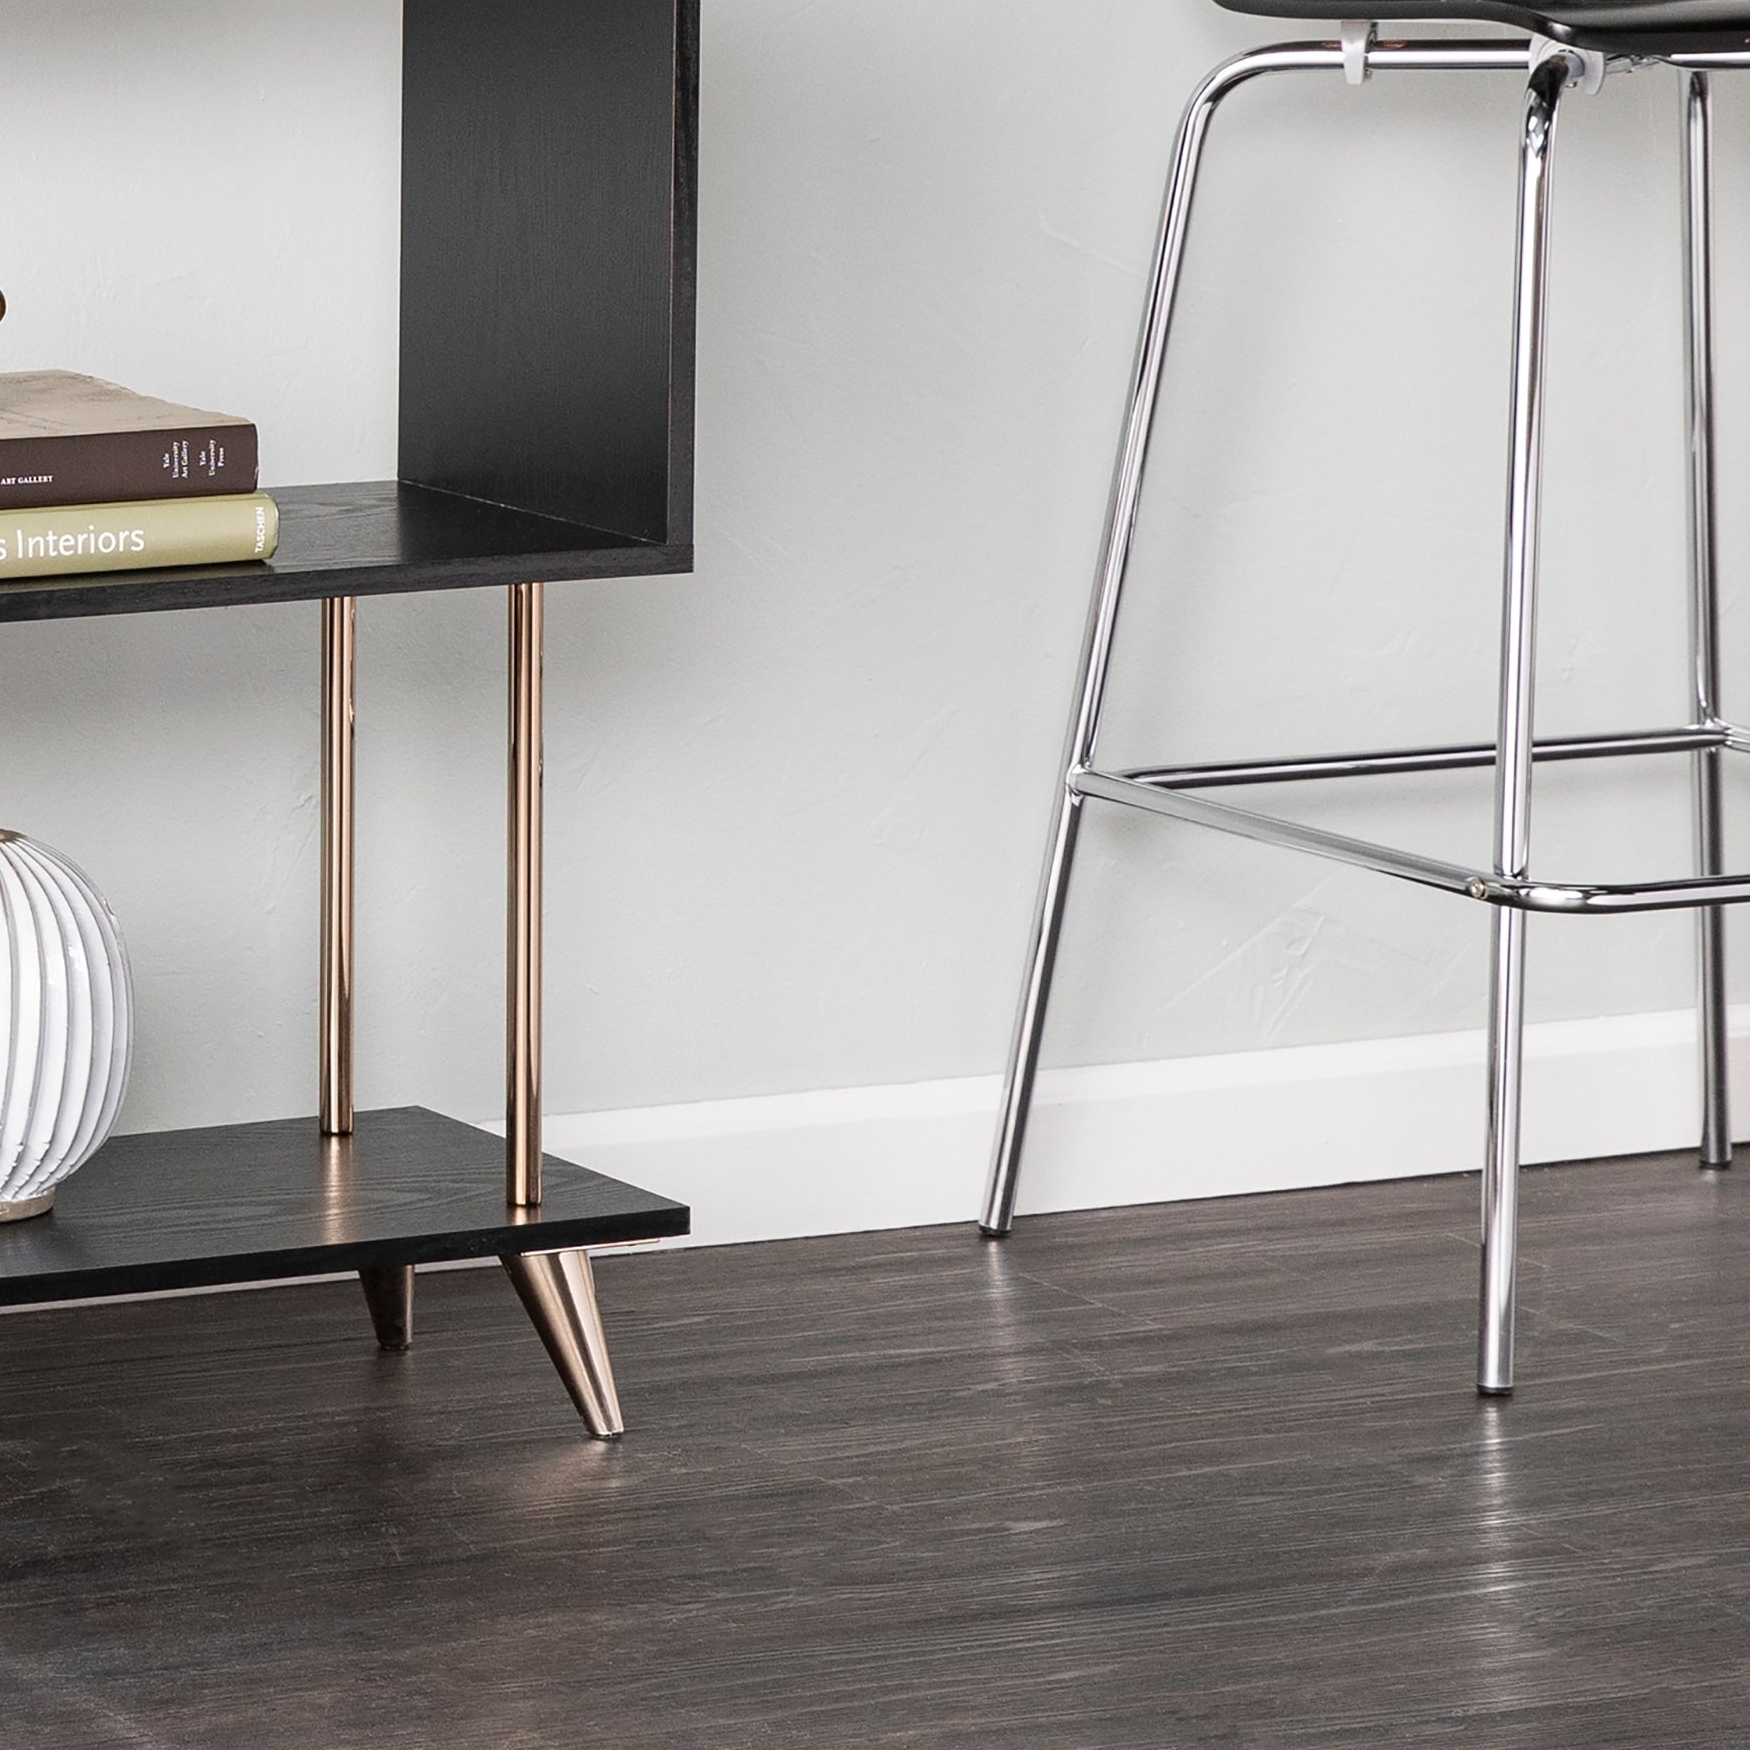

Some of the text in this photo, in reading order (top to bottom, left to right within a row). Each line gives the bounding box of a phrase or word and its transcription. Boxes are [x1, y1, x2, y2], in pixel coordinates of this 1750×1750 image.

[162, 453, 170, 468] Yale
[172, 441, 180, 478] University
[181, 440, 189, 466] Gallery
[199, 451, 207, 466] Yale
[208, 439, 217, 476] University
[217, 447, 225, 467] Press
[0, 477, 17, 486] ART
[17, 475, 54, 484] GALLERY
[16, 525, 145, 559] Interiors
[254, 506, 265, 554] TASCHEN
